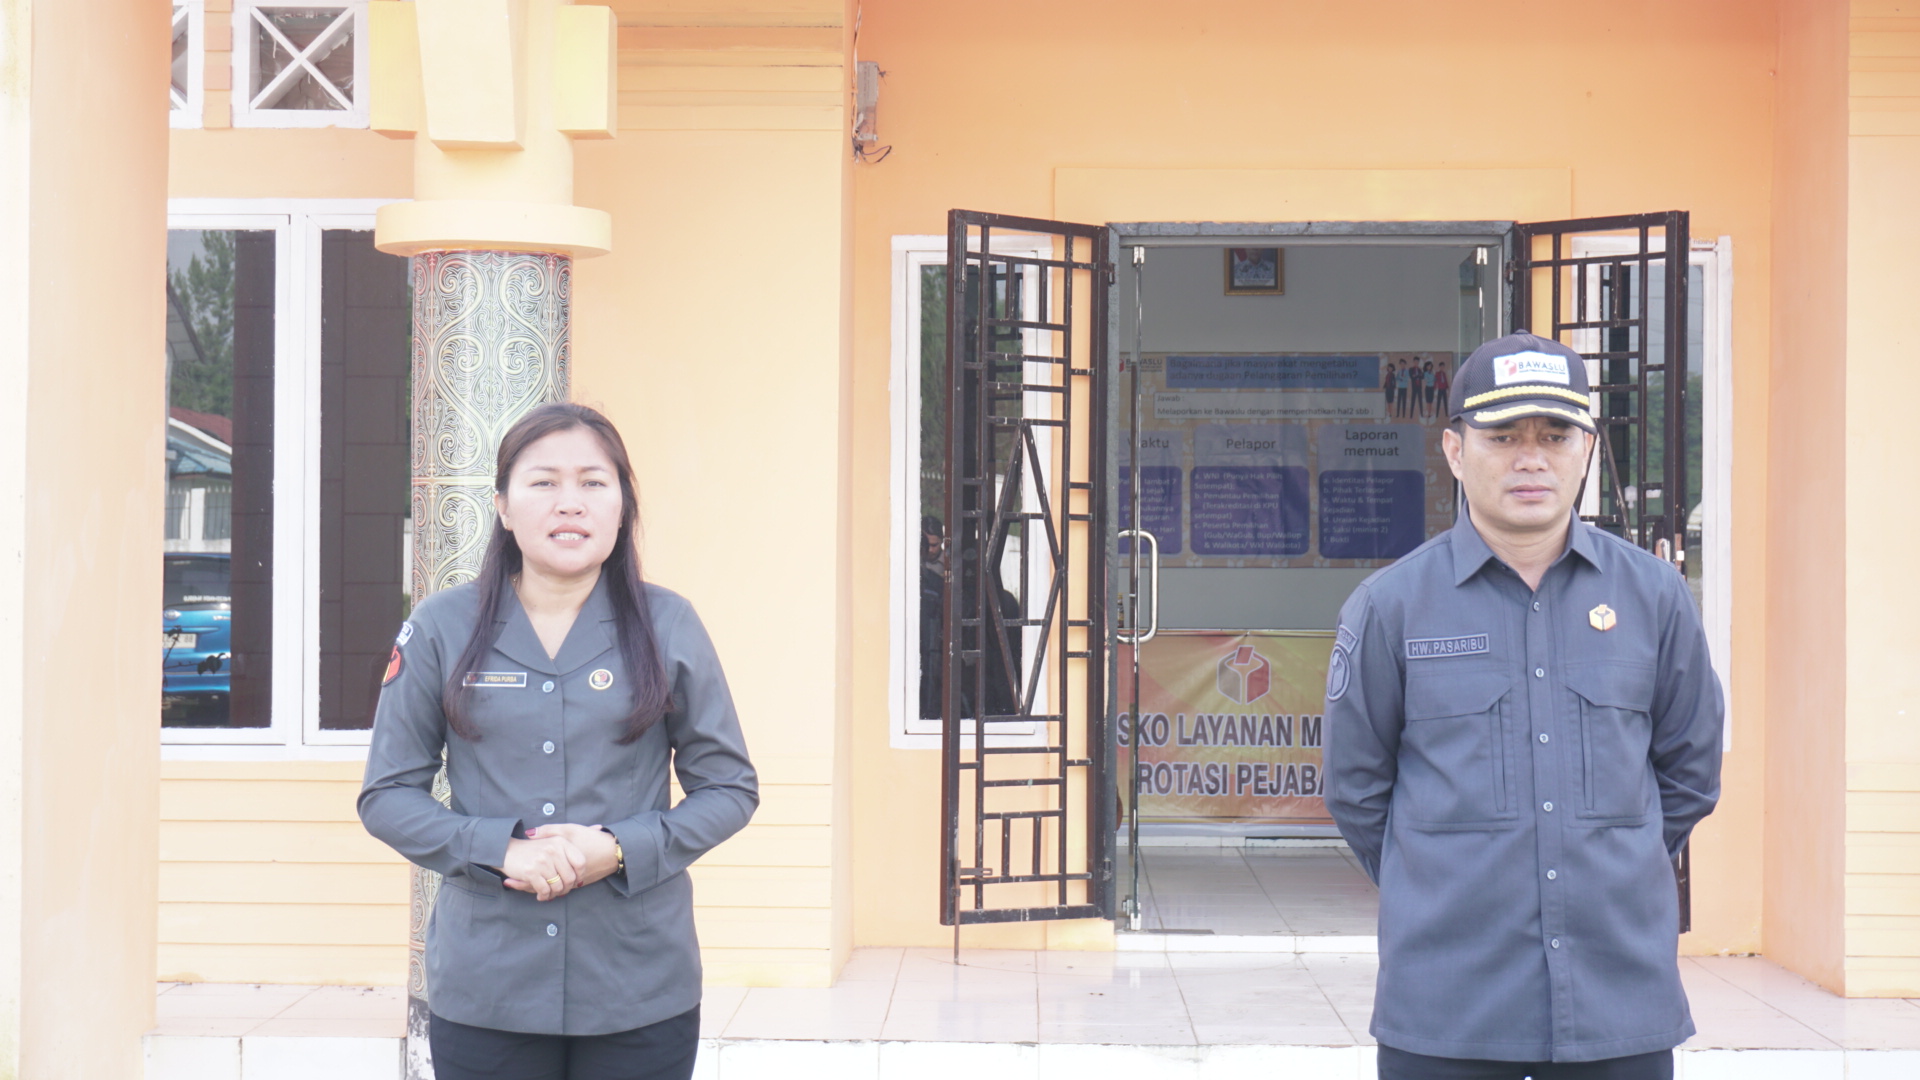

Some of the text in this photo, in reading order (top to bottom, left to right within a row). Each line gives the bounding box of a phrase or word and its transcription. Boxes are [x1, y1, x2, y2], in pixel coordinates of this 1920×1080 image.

[1170, 359, 1357, 369] Bagaimana jika masyarakat mengetahui
[1519, 361, 1566, 371] BAWASLU
[1170, 370, 1358, 381] adanya dugaan Pelanggaran Pemilihan?
[1157, 394, 1180, 402] Jawab
[1157, 408, 1202, 416] Melaporkan
[1248, 408, 1274, 416] dengan
[1277, 408, 1336, 416] memperhatikan
[1345, 430, 1398, 442] Laporan
[1128, 437, 1169, 448] aktu
[1226, 438, 1276, 450] Pelapor
[1344, 446, 1400, 456] memuat
[1434, 637, 1485, 654] PASARIBU
[1177, 714, 1292, 747] LAYANAN
[1138, 762, 1229, 796] ROTASI
